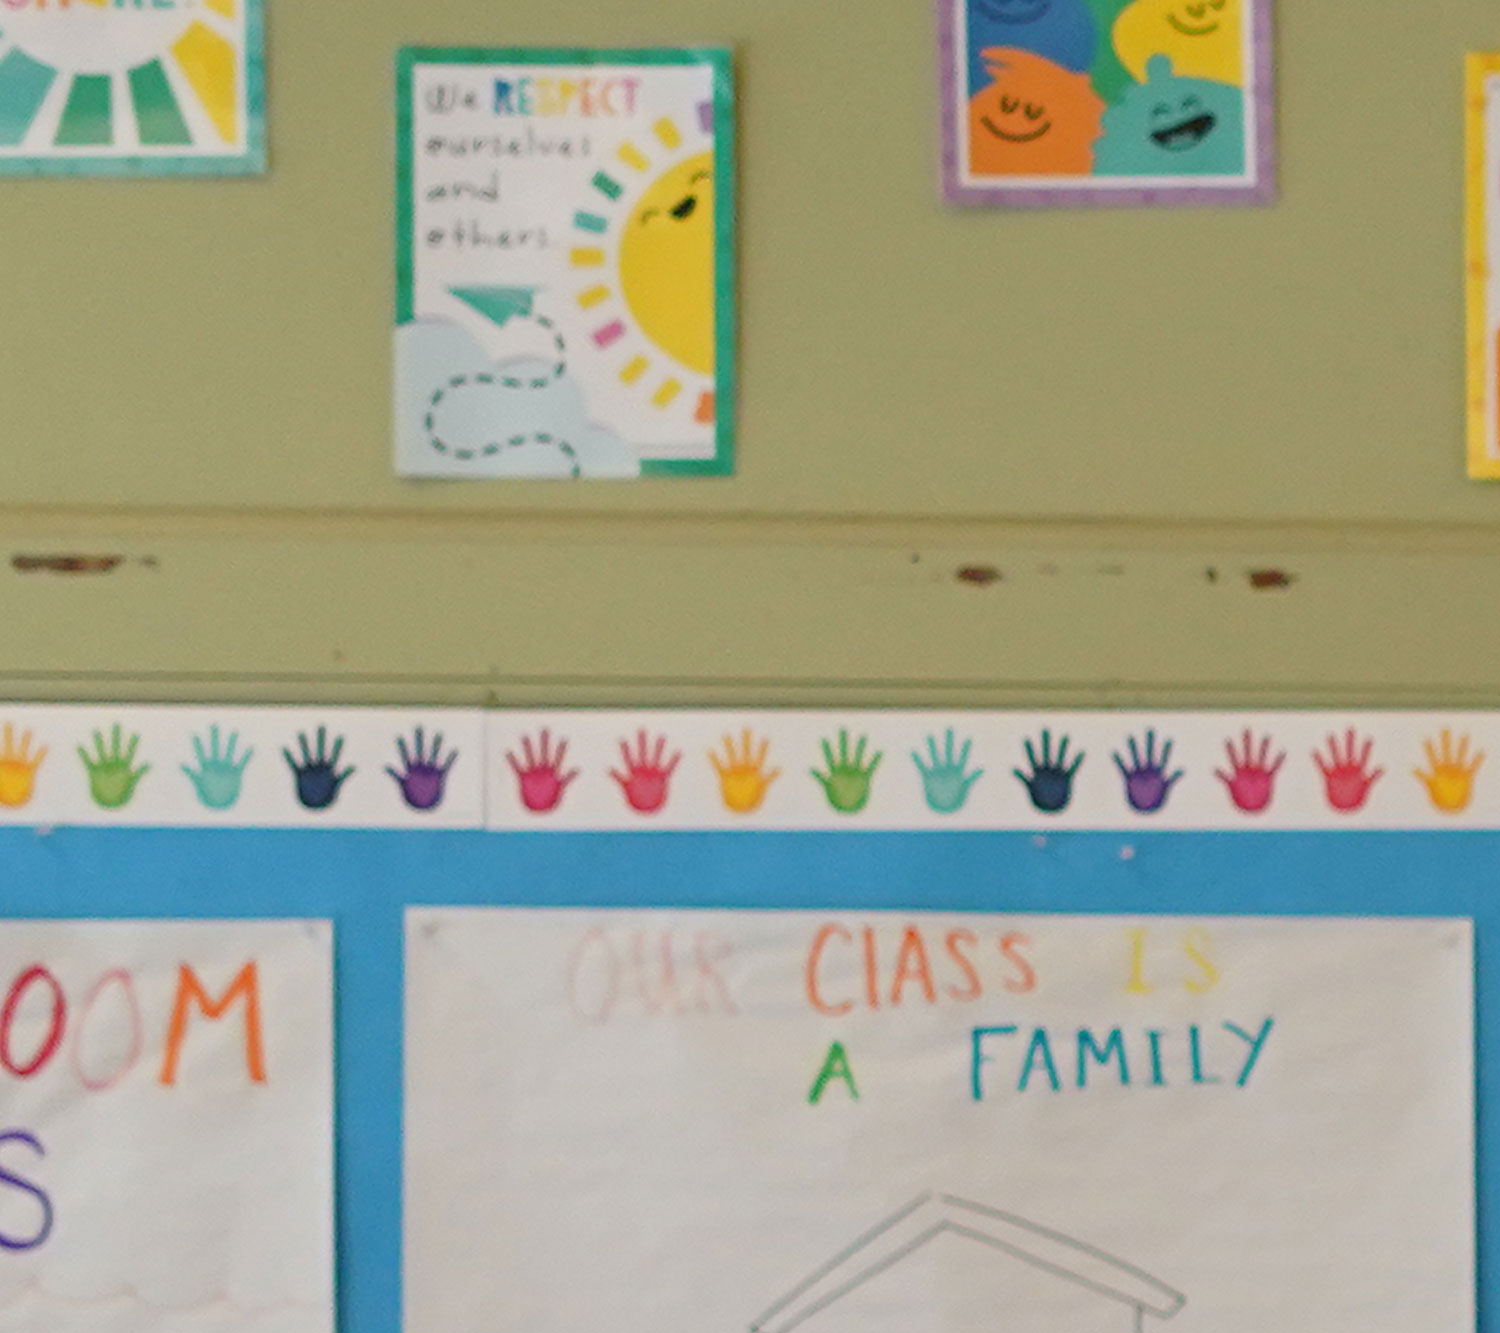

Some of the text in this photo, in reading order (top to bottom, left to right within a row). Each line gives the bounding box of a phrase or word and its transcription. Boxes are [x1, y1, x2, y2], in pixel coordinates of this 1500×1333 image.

[425, 76, 640, 117] We RESPECT
[426, 168, 499, 203] and
[806, 1015, 1276, 1104] A FAMILY
